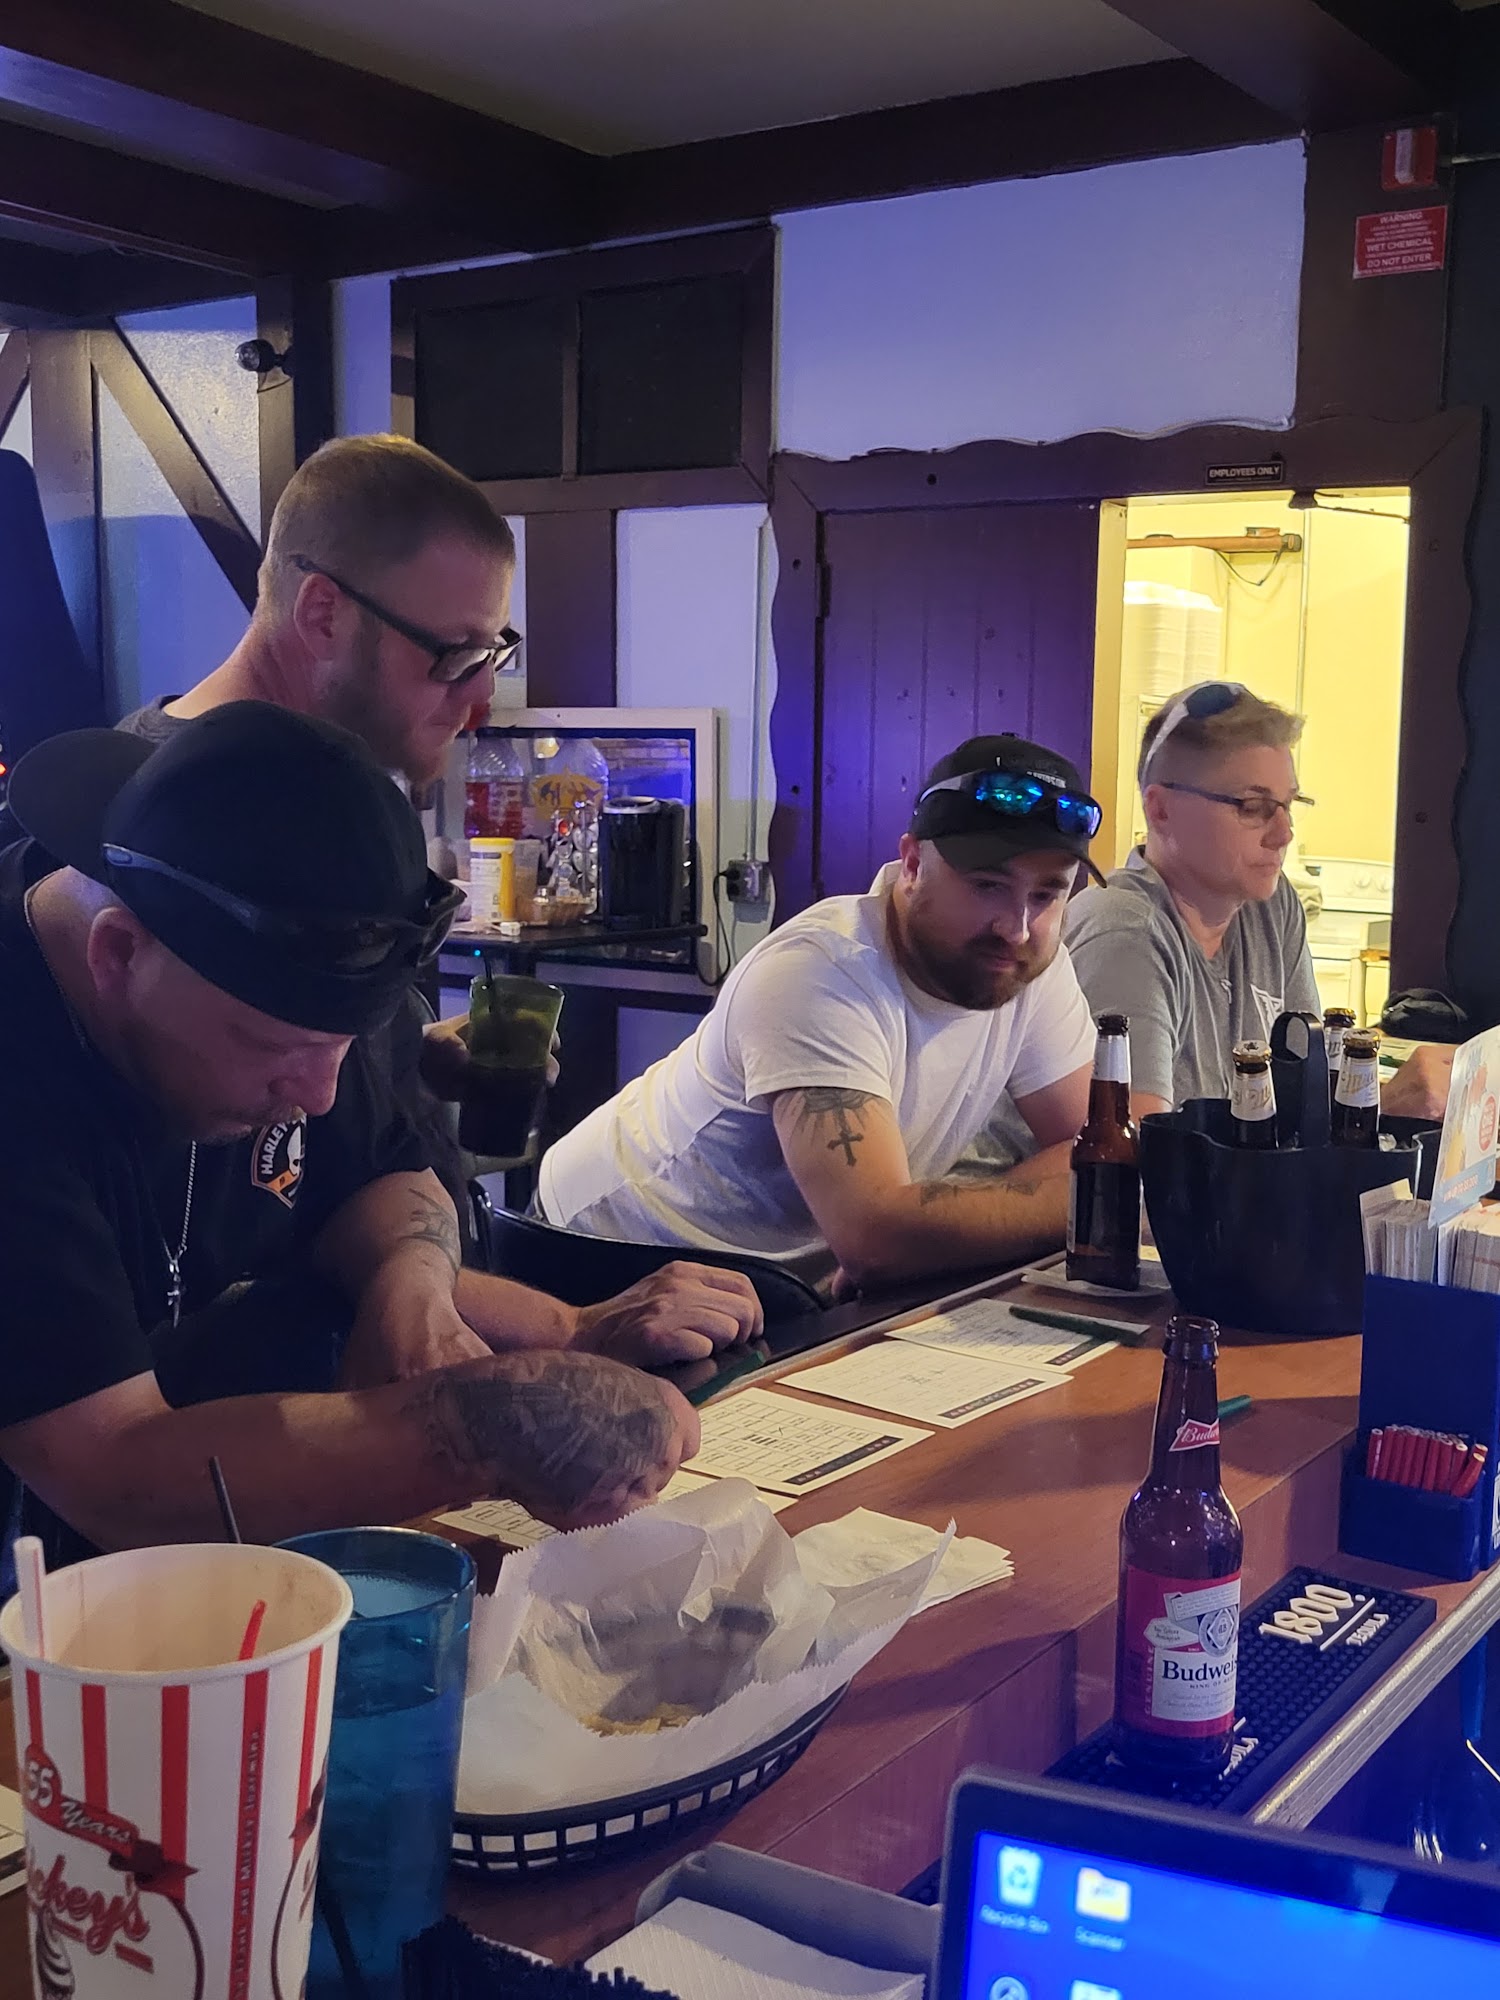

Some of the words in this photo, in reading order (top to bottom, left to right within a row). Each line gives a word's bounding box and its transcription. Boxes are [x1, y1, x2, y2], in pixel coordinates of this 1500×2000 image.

[1380, 211, 1423, 224] WARNING
[1367, 243, 1386, 252] WET
[1387, 237, 1434, 250] CHEMICAL
[1367, 259, 1380, 268] DO
[1381, 256, 1401, 266] NOT
[1402, 253, 1432, 264] ENTER
[1209, 467, 1256, 478] EMPLOYEES
[1257, 466, 1279, 476] ONLY
[261, 1122, 288, 1174] HARLEY
[61, 1801, 132, 1843] Years
[981, 1904, 1026, 1930] Recycle
[1027, 1915, 1049, 1934] Bin
